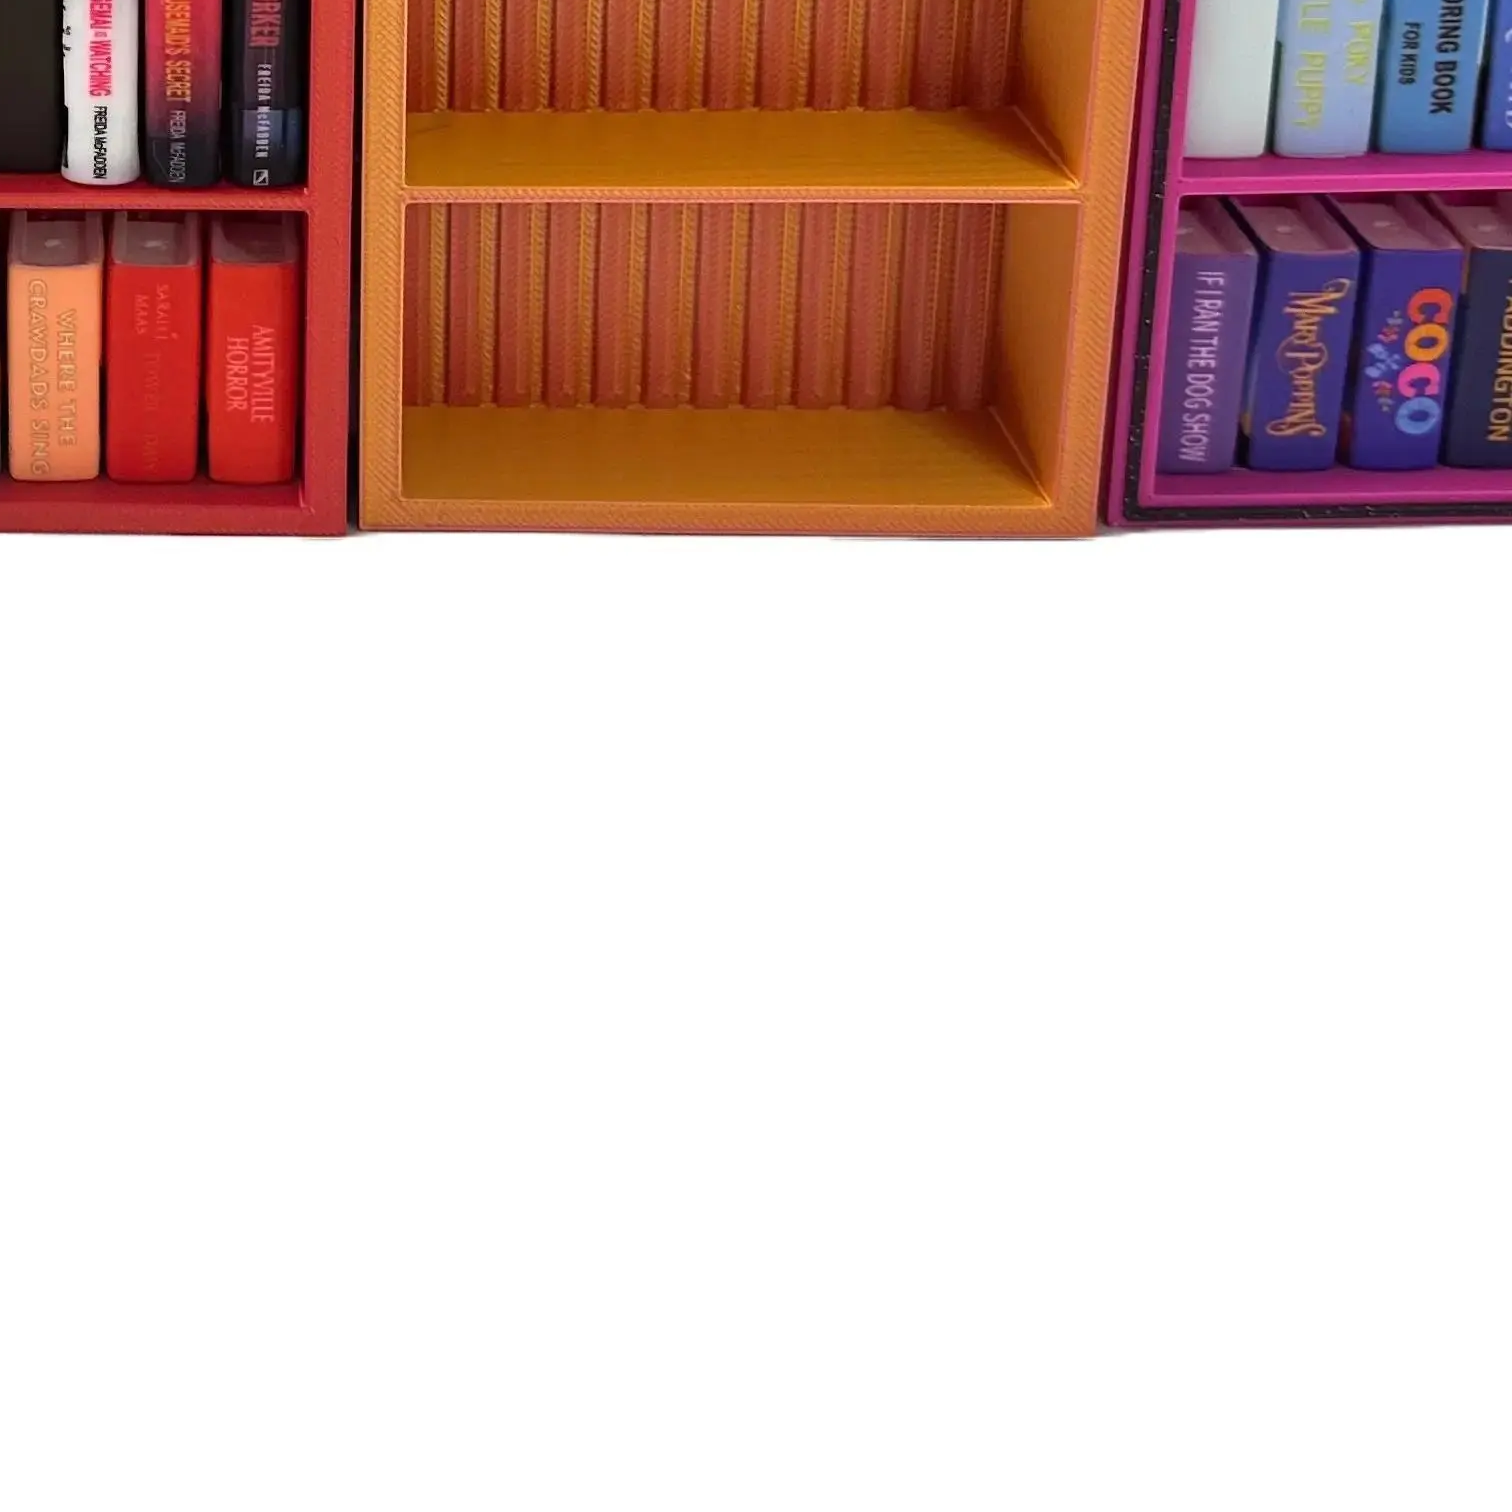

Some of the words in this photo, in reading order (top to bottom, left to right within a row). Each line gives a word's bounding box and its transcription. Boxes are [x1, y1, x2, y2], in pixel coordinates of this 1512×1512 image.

[1402, 21, 1423, 53] FOR
[1292, 51, 1327, 130] PUPPY
[1428, 60, 1459, 115] BOOK
[1196, 271, 1225, 287] IF
[1191, 299, 1224, 332] RAN
[27, 278, 50, 411] CRAWDADS
[56, 308, 77, 392] WHERE
[1187, 336, 1219, 369] THE
[1394, 288, 1453, 435] COCO
[225, 336, 249, 412] HORROR
[250, 324, 275, 424] AMITYVILLE
[1183, 374, 1215, 409] DOG
[30, 420, 51, 476] SING
[58, 398, 77, 448] THE
[1178, 412, 1212, 462] SHOW
